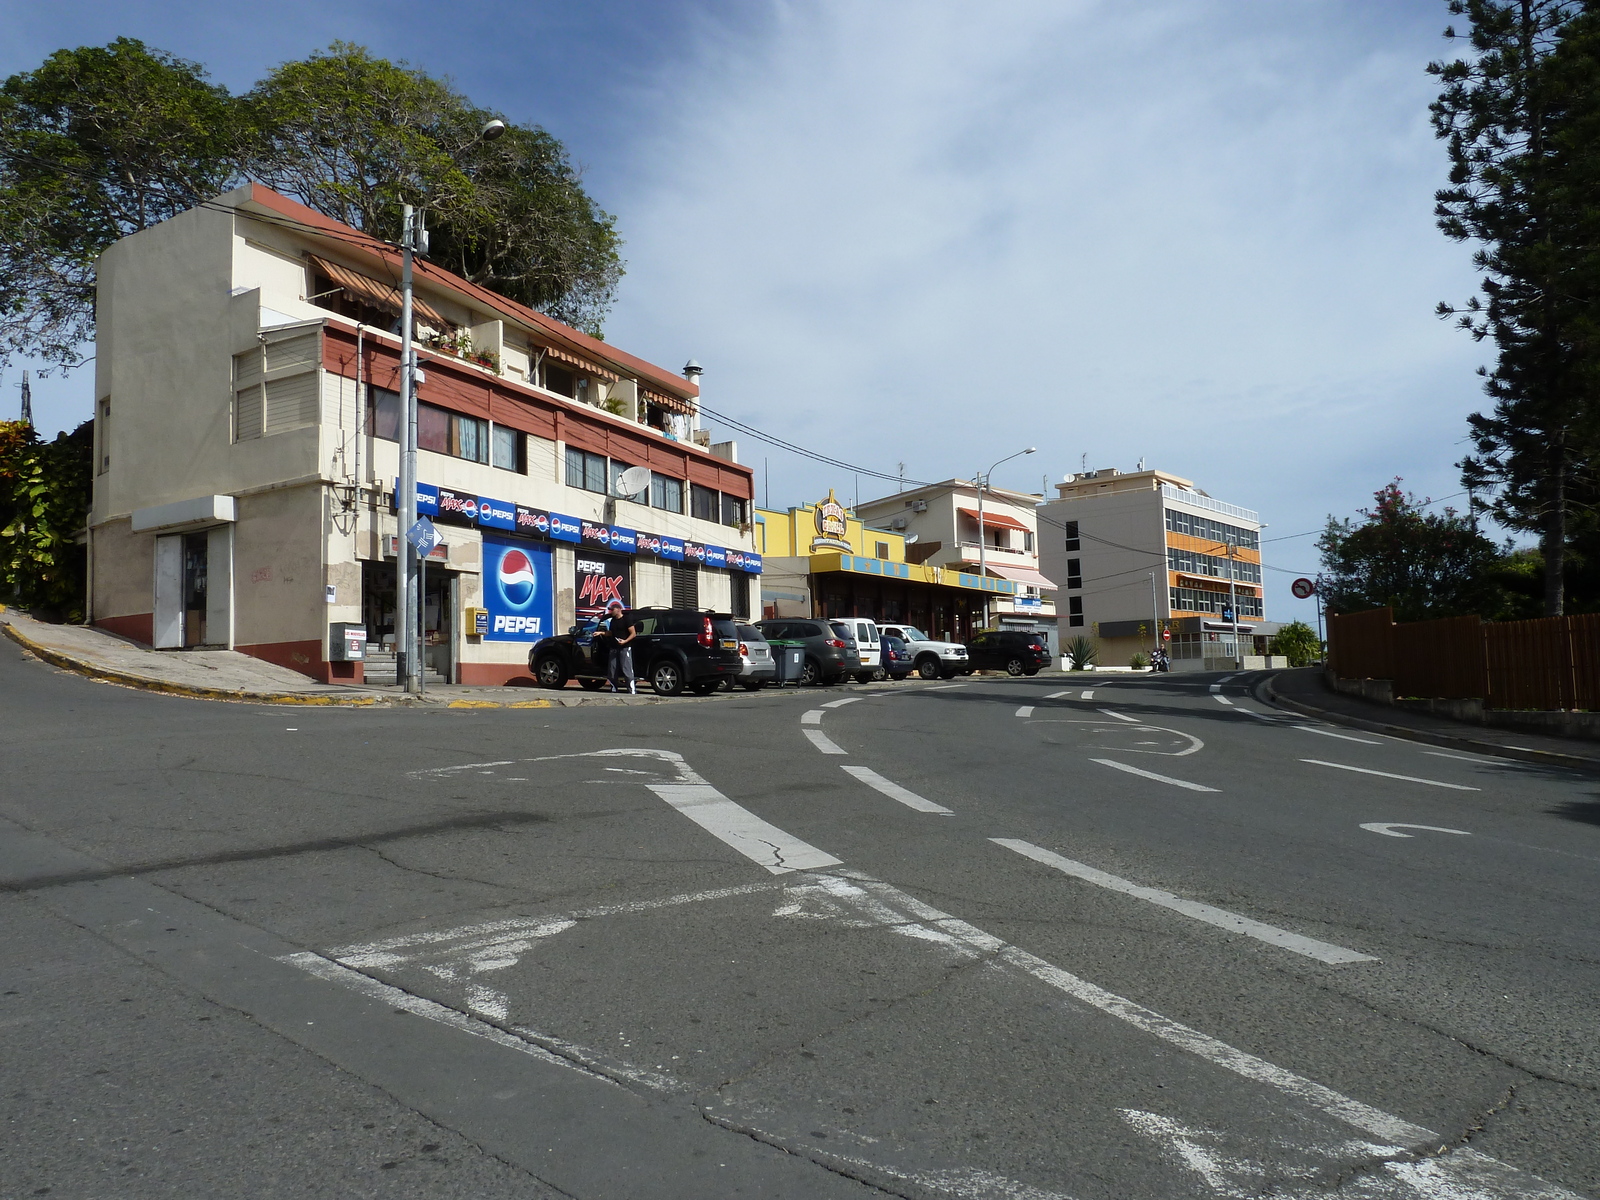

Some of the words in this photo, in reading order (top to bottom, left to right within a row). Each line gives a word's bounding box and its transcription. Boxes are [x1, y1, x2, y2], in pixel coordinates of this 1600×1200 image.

[417, 493, 436, 505] EPSI
[440, 497, 463, 511] MAX
[492, 509, 514, 520] PEPSI
[517, 513, 536, 526] MAX
[561, 523, 580, 534] PEPSI
[619, 535, 635, 544] PEPSI
[669, 544, 683, 553] PEPSI
[712, 552, 725, 560] PEPSI
[577, 559, 605, 574] PEPSI
[579, 574, 623, 606] MAX
[494, 615, 541, 634] PEPSI
[1157, 620, 1180, 628] BR
